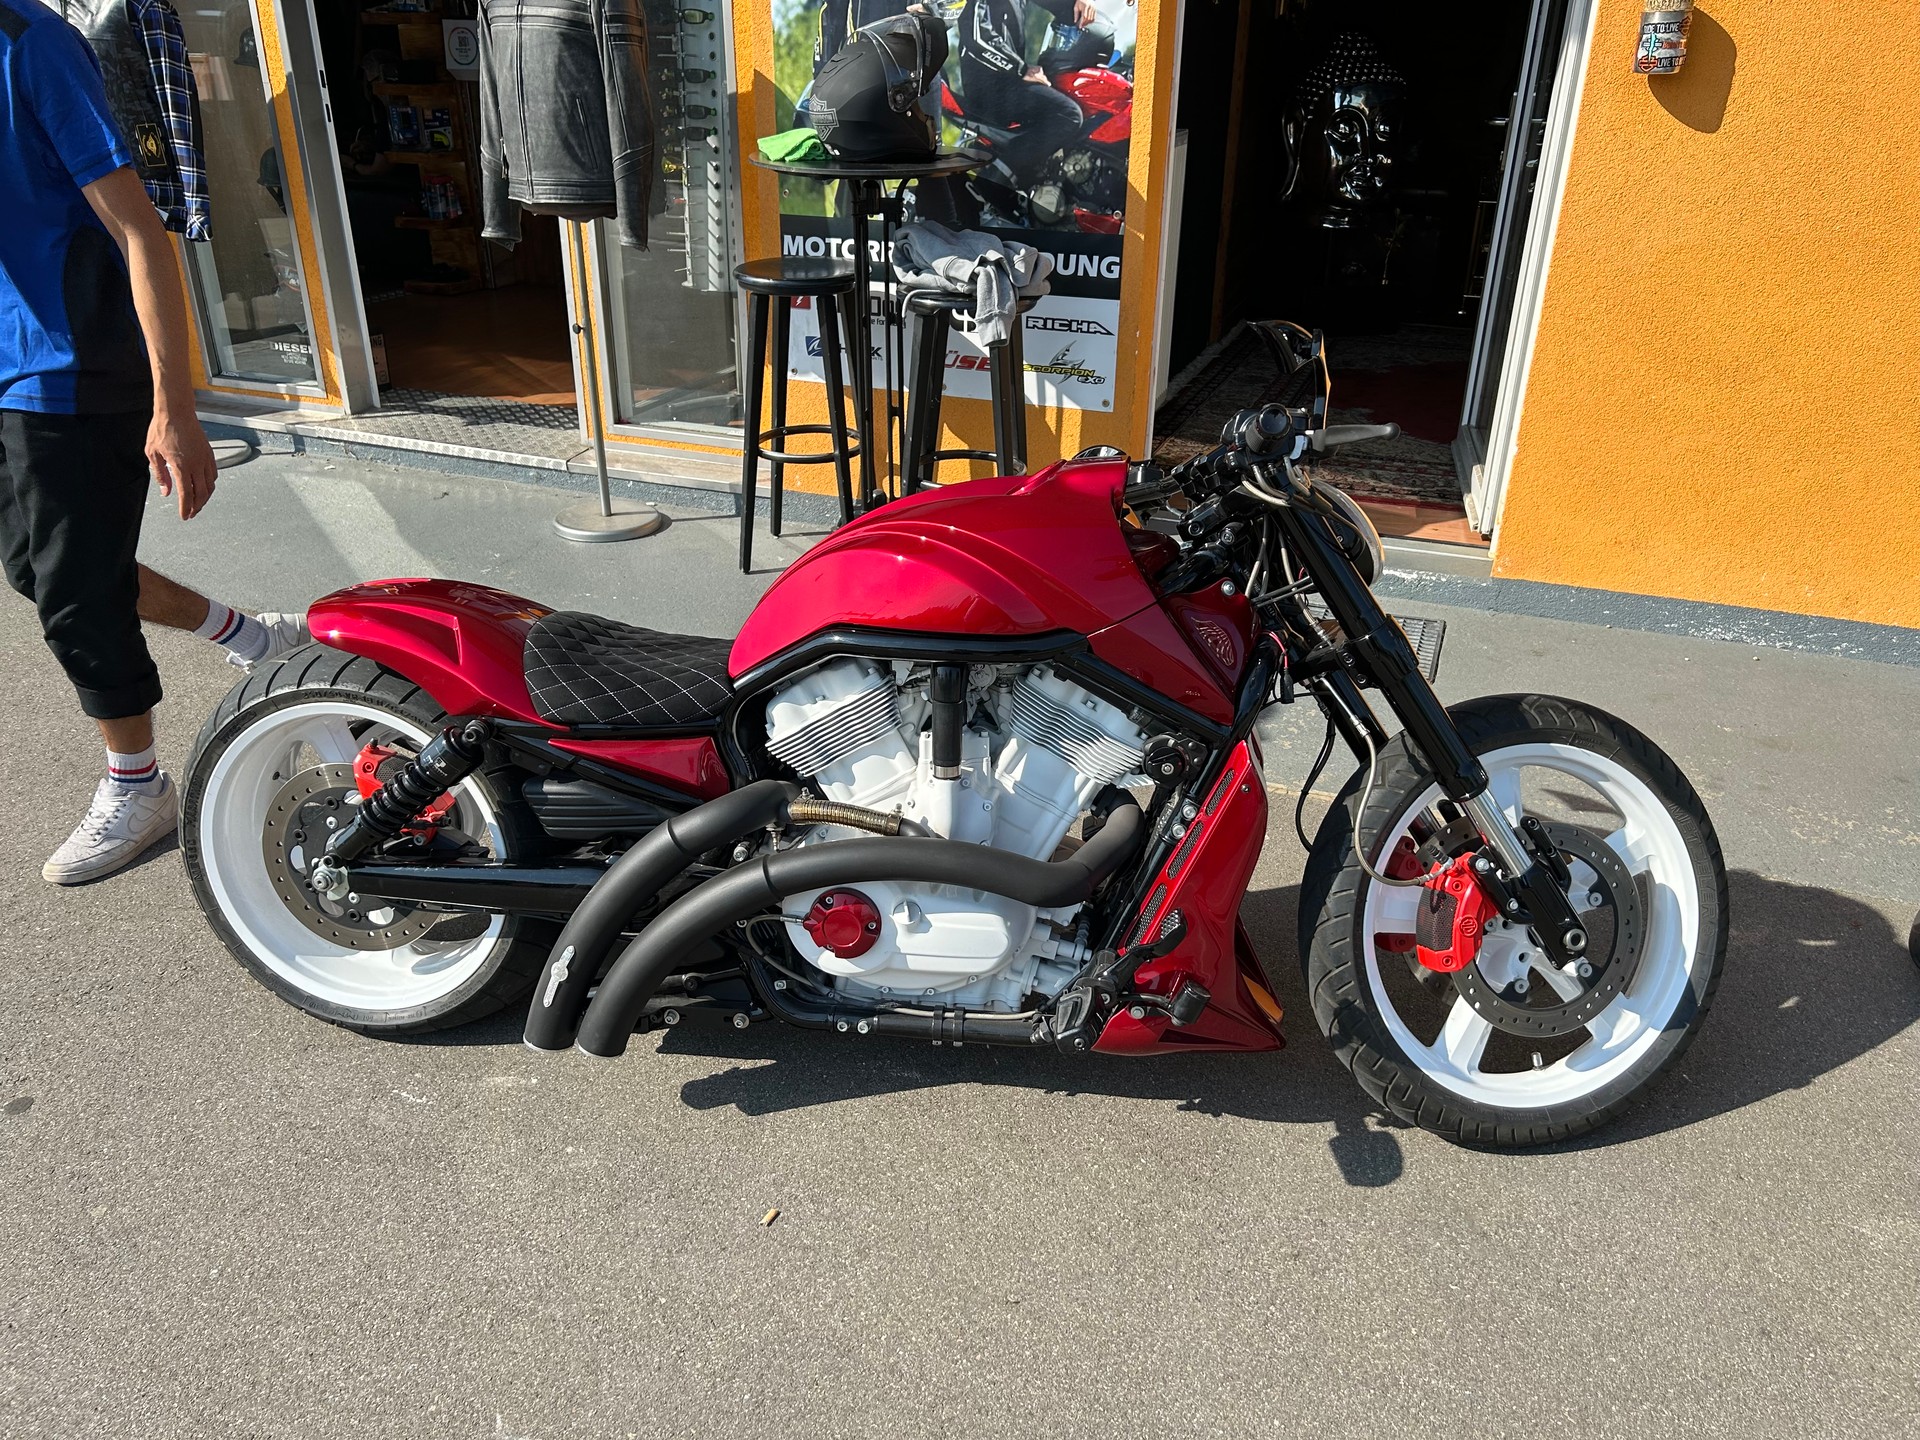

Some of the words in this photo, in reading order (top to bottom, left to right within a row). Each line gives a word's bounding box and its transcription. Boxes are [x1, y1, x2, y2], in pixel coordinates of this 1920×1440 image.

[1026, 316, 1115, 336] RICHA
[944, 350, 991, 372] ÜSE
[1022, 363, 1096, 378] SCORPION
[1076, 375, 1106, 385] EXO
[1667, 802, 1718, 920] METZELER
